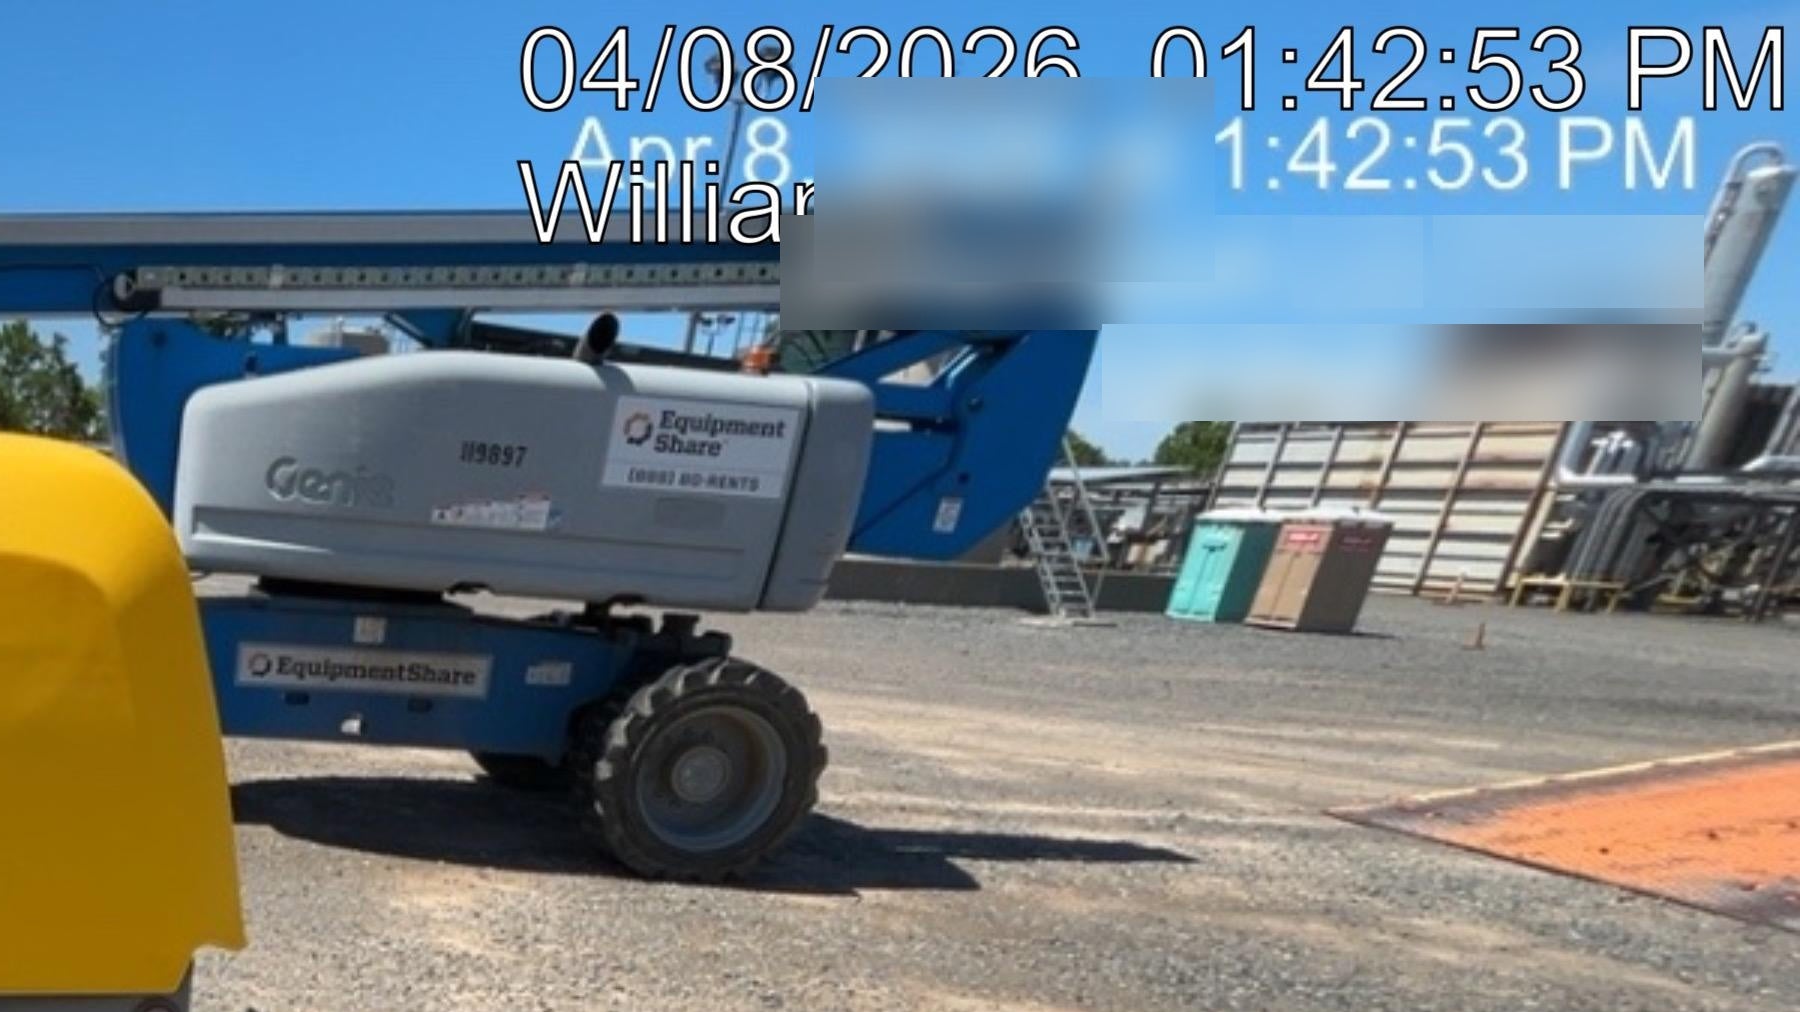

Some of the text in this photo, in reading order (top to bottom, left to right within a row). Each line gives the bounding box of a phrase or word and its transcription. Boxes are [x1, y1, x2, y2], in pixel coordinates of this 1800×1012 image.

[658, 410, 786, 438] Equipment
[653, 434, 724, 457] Share
[265, 455, 395, 506] Genie
[275, 656, 477, 686] EquipmentShare
